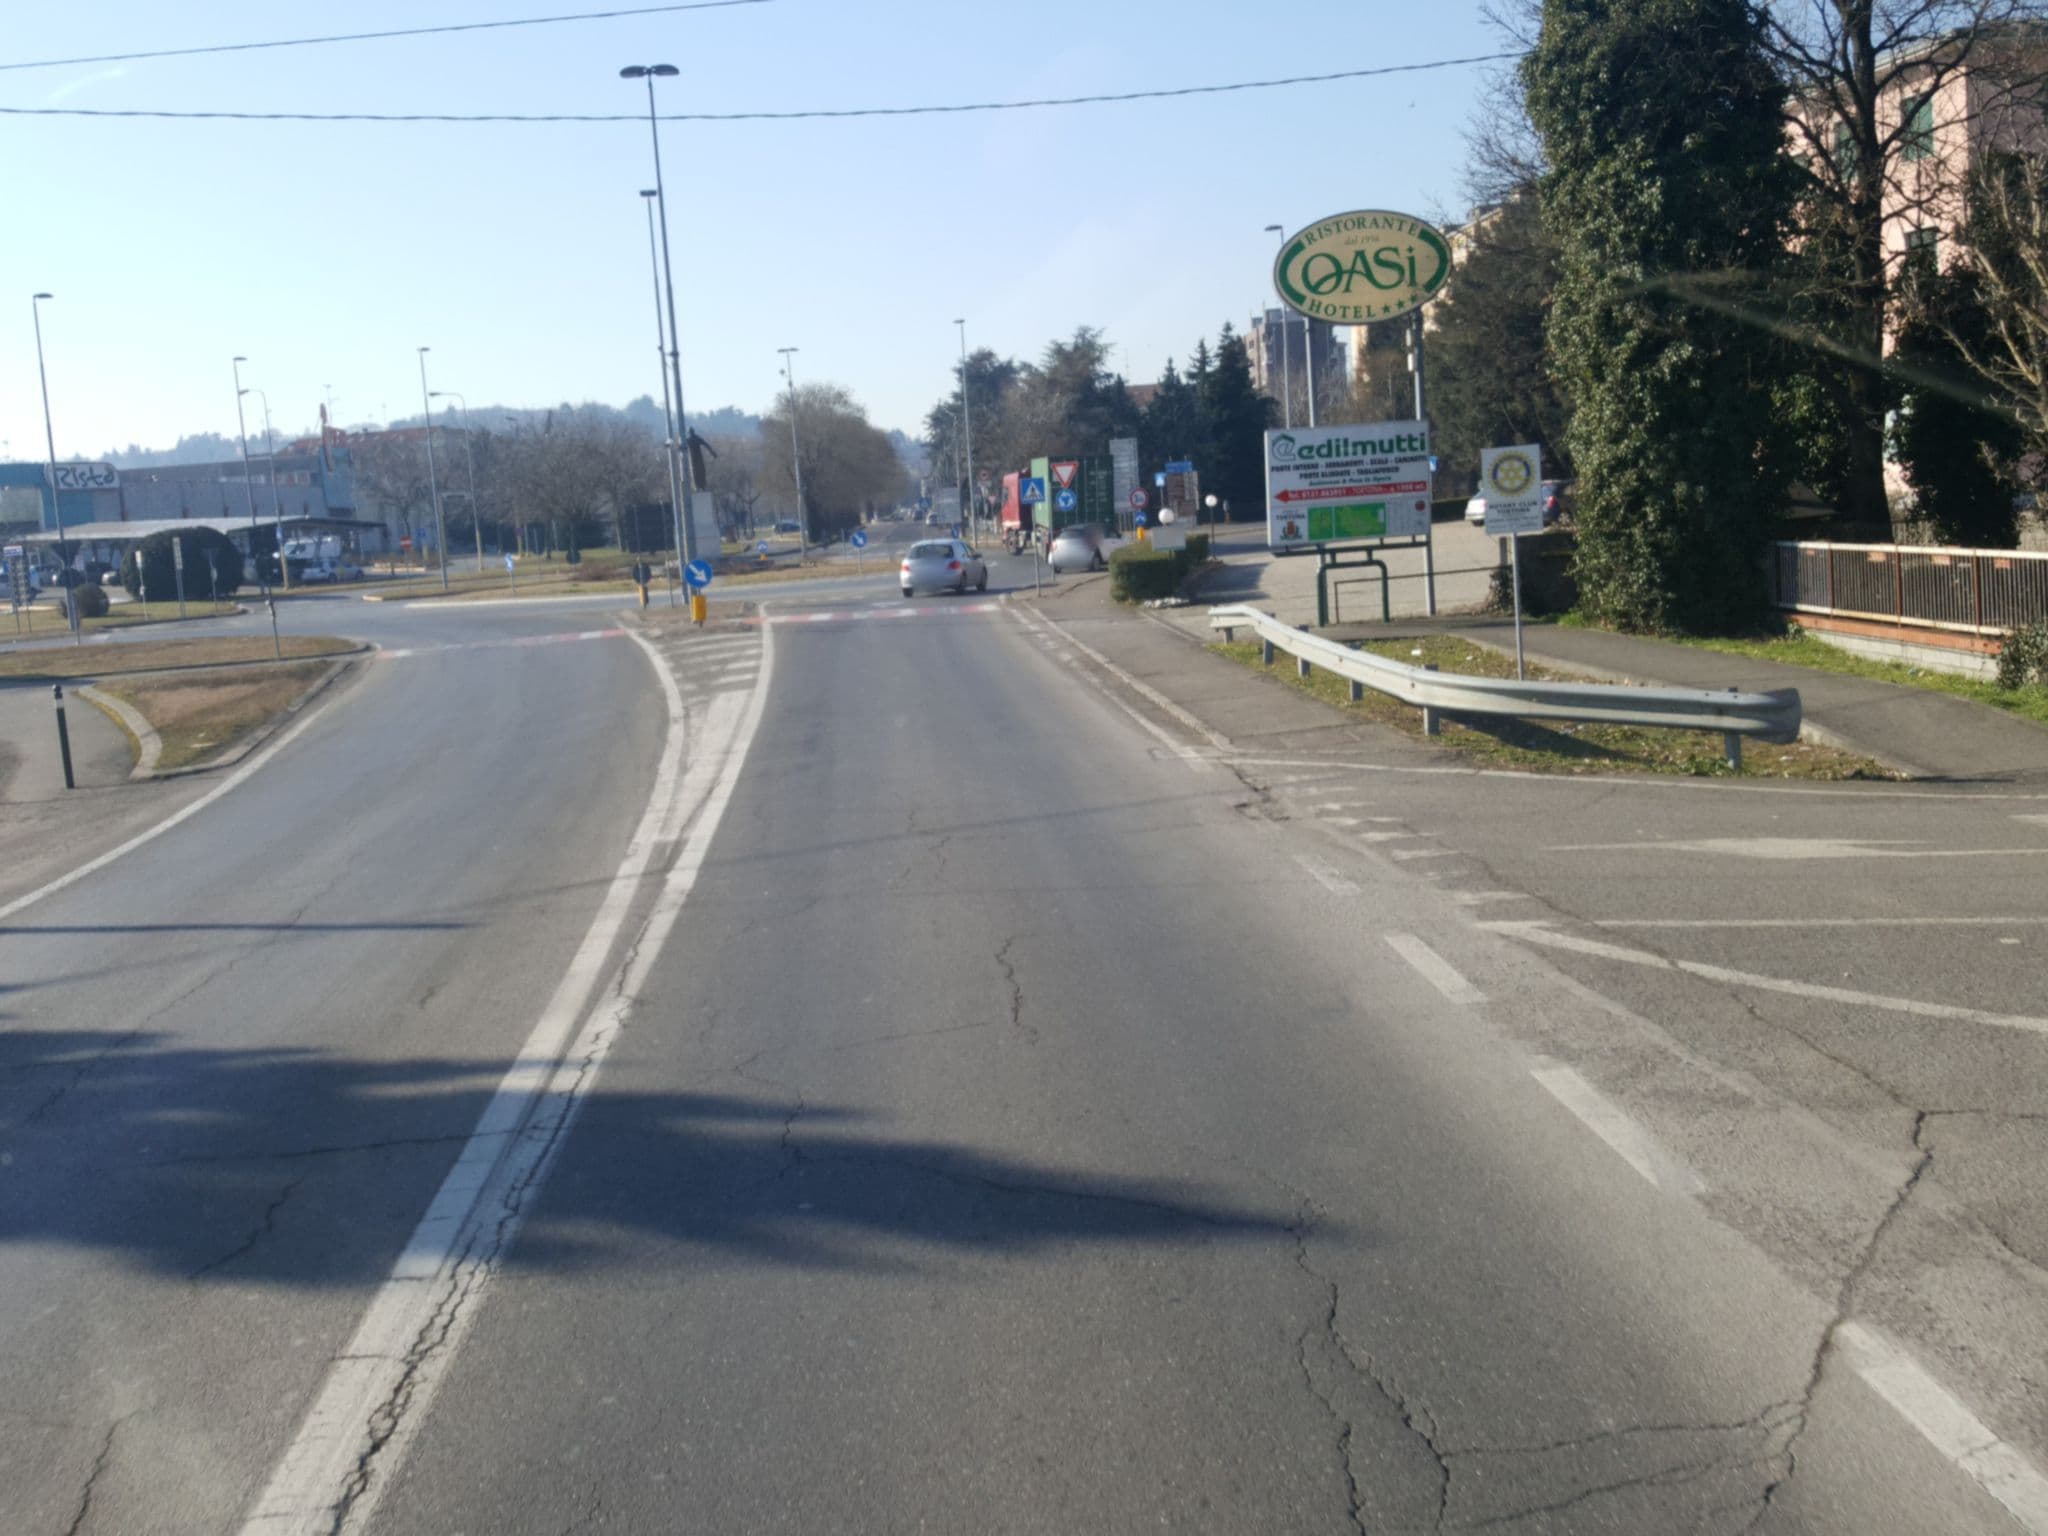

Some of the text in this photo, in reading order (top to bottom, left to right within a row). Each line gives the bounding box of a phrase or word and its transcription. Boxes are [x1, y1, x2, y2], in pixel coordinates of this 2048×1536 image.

[1305, 216, 1418, 245] RISTORANTE
[1309, 299, 1376, 319] HOTEL
[1298, 433, 1426, 459] edilmutti
[1271, 464, 1291, 472] PORTE
[1299, 471, 1319, 479] PORTE
